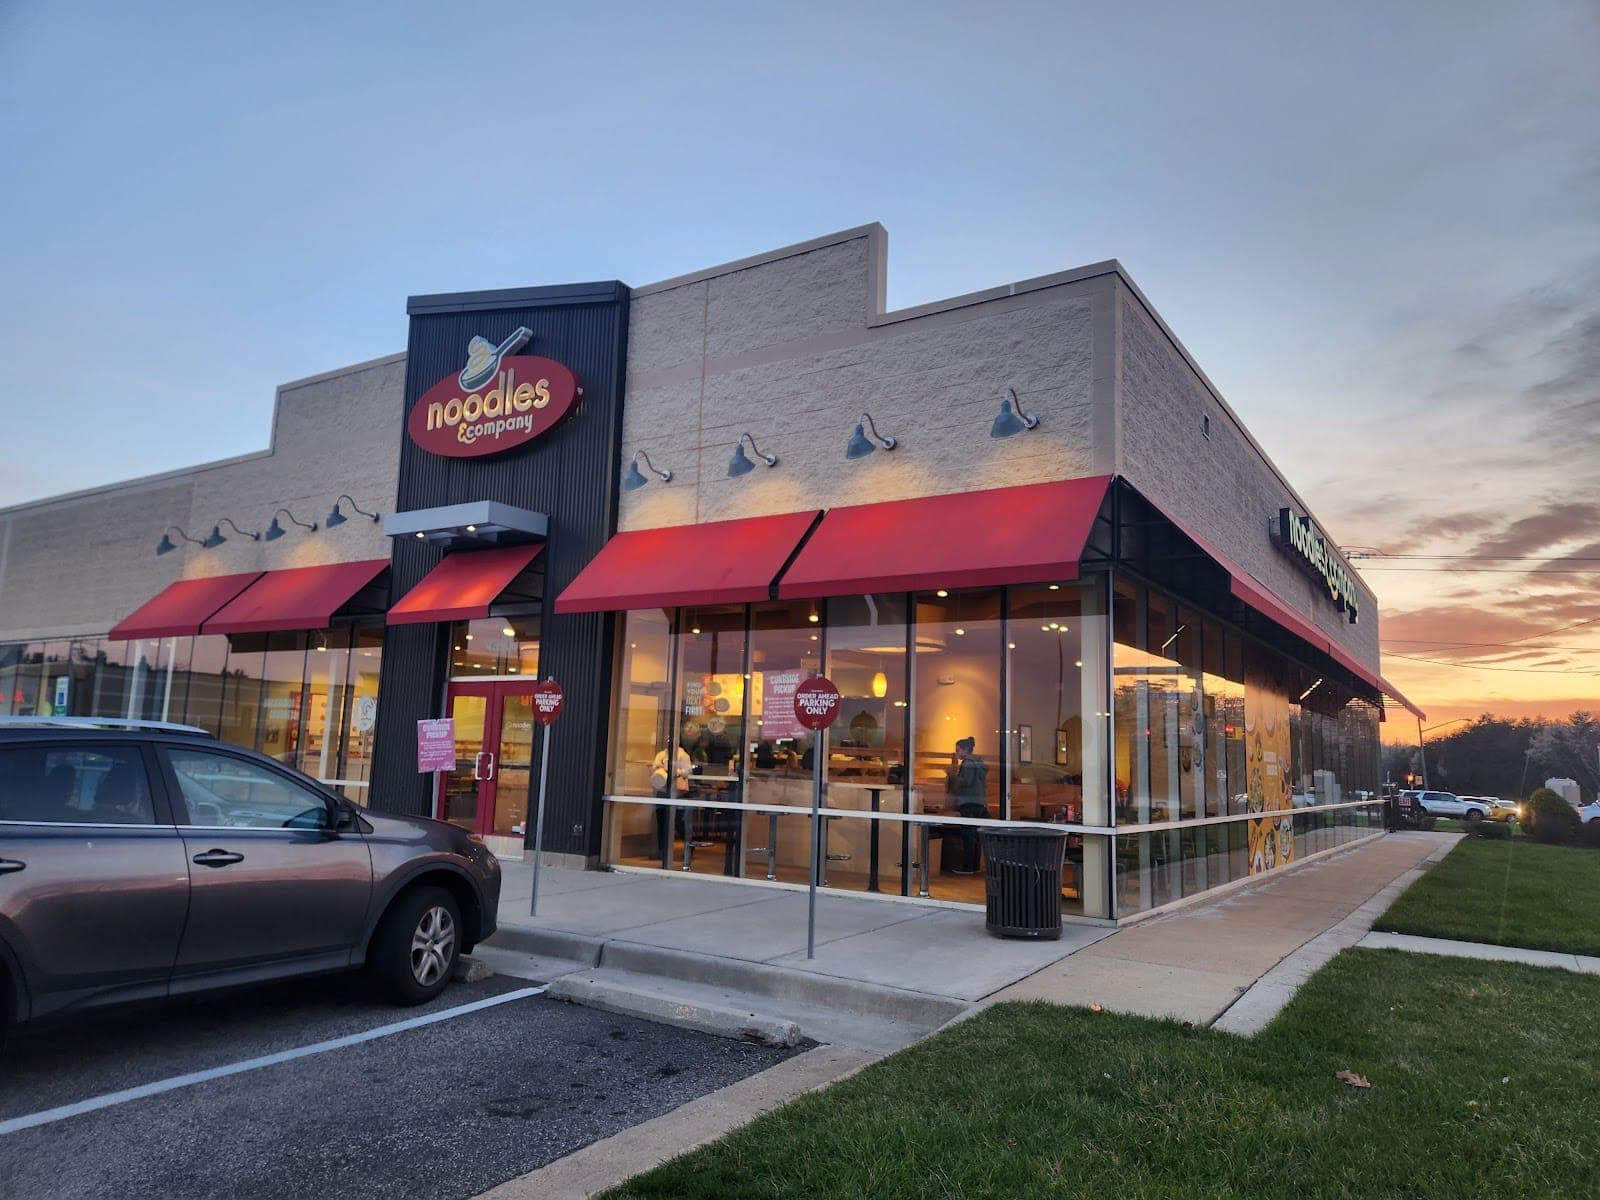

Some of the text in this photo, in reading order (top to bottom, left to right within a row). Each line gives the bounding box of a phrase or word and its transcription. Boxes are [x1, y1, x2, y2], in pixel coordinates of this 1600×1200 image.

[426, 368, 550, 431] noodles
[1289, 509, 1326, 577] noodles
[535, 698, 560, 706] PARKING
[799, 699, 836, 707] PARKING
[806, 706, 829, 715] ONLY
